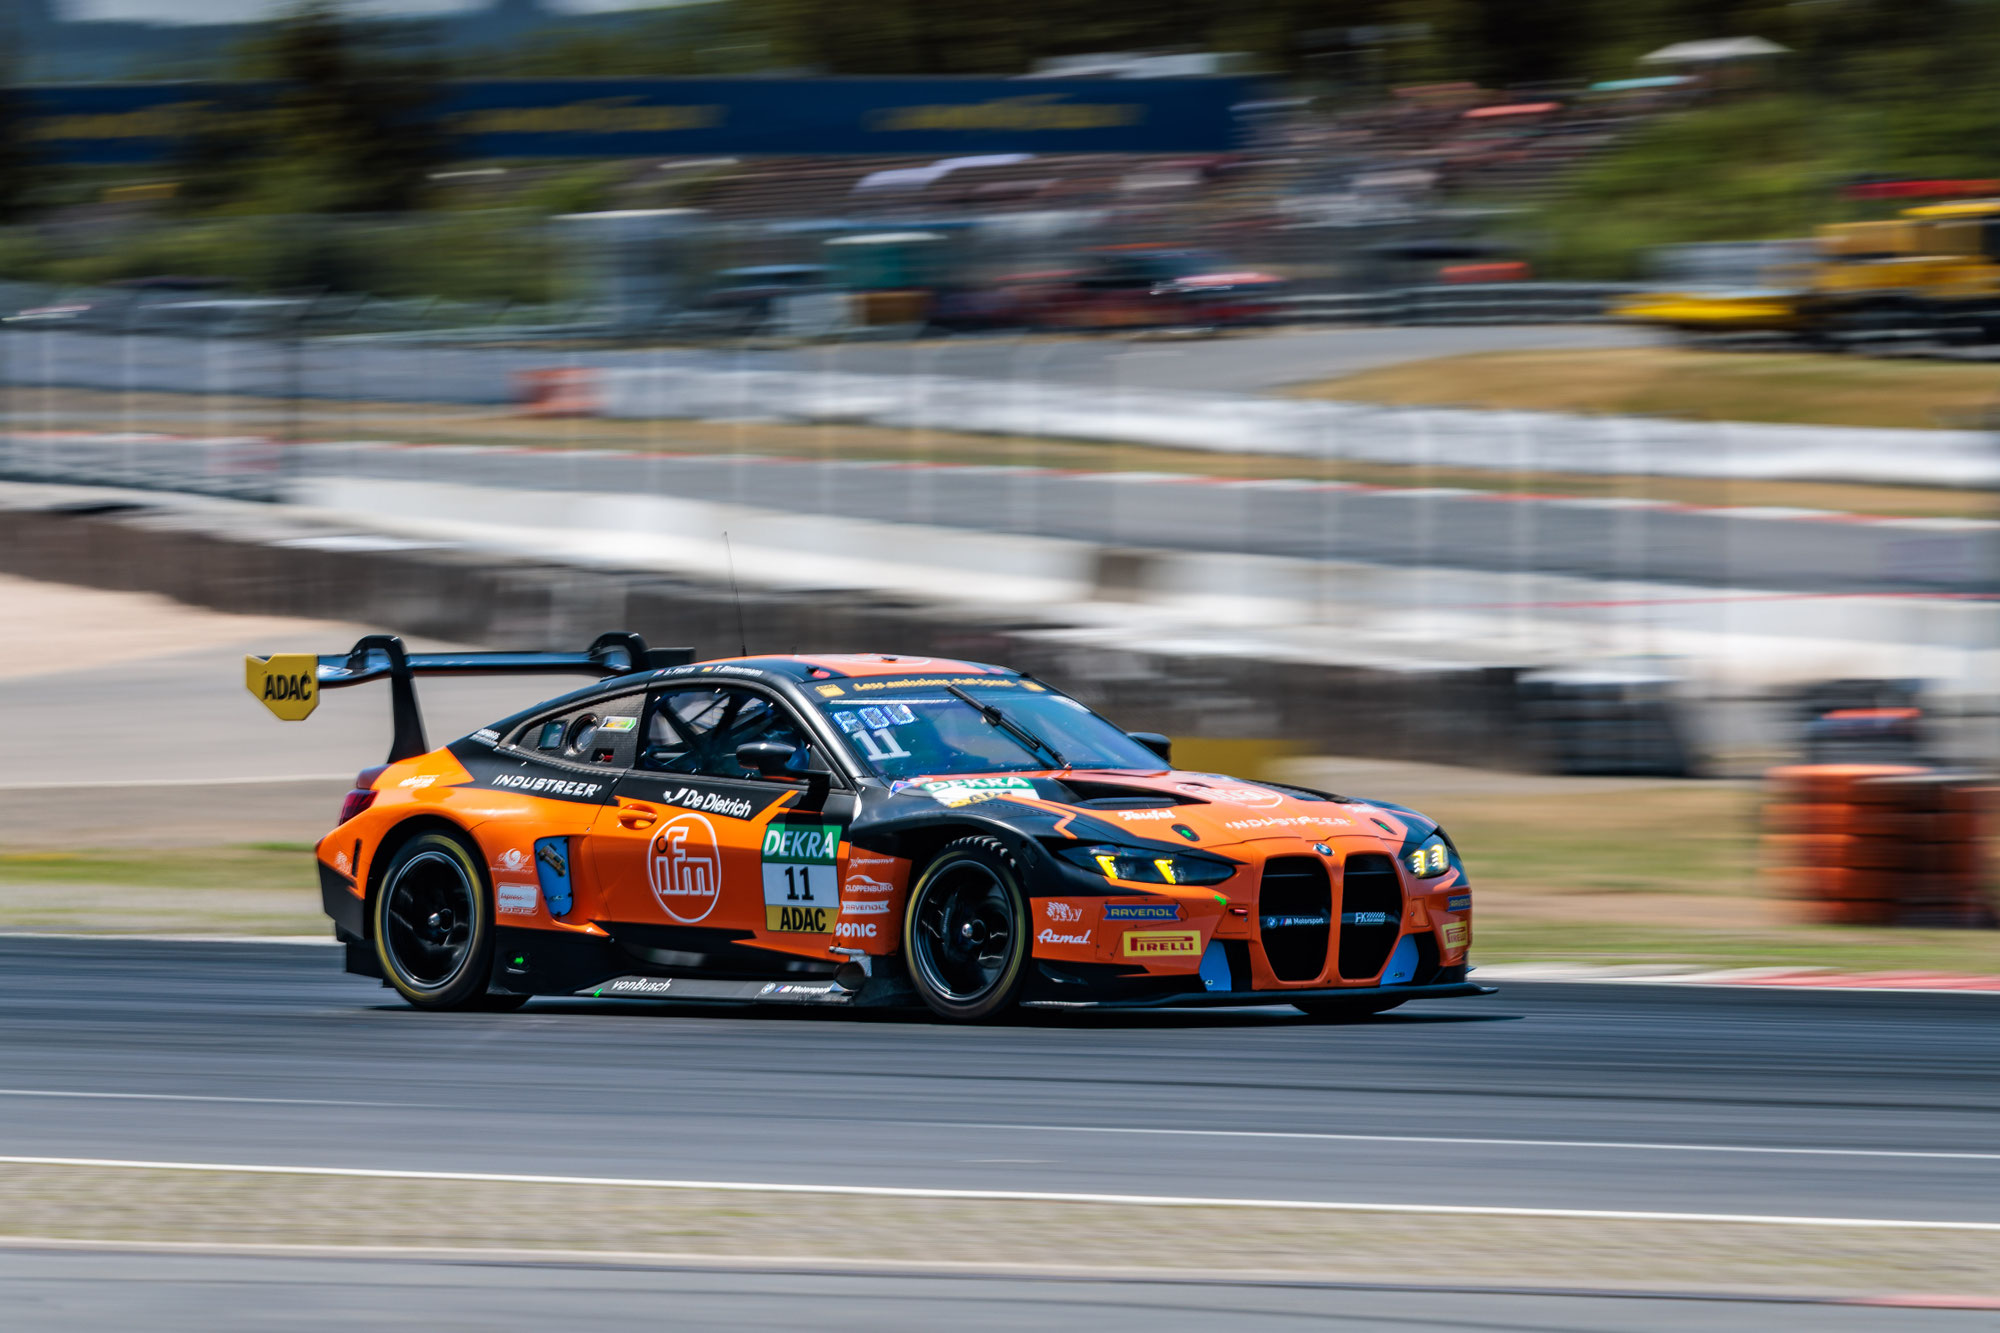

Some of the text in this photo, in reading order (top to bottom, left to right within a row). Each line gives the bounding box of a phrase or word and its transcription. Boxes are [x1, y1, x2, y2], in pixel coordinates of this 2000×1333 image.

[263, 673, 312, 701] ADAC
[851, 728, 912, 762] 11
[924, 776, 1030, 792] DEKRA
[681, 789, 752, 818] De Dietrich
[763, 829, 835, 860] DEKRA
[784, 865, 815, 902] 11
[845, 883, 894, 893] CLOPPENBURG
[780, 906, 827, 933] ADAC
[1110, 908, 1173, 917] RAVENOL
[1037, 928, 1091, 944] Armal
[1130, 936, 1194, 952] PIRELLI
[611, 978, 673, 993] vonBusch
